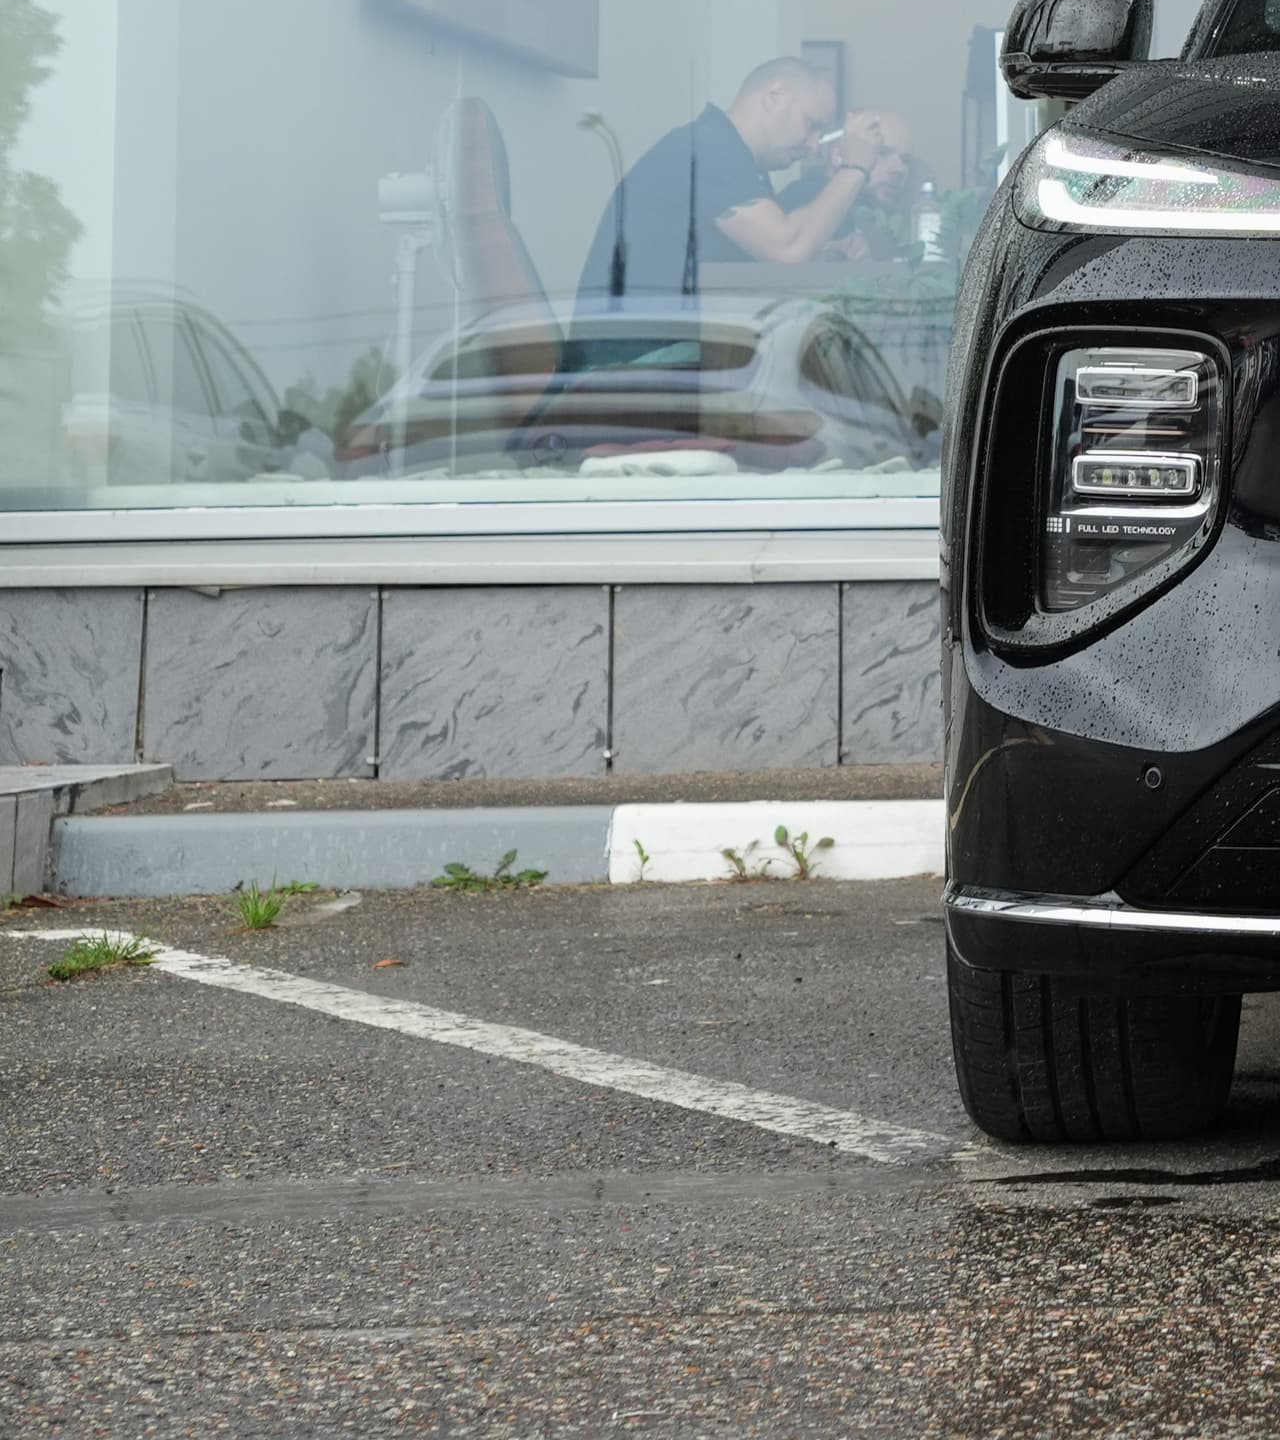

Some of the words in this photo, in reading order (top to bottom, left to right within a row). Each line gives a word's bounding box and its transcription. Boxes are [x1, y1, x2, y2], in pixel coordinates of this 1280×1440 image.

[1078, 525, 1099, 533] FULL
[1102, 525, 1119, 534] LED
[1123, 526, 1177, 536] TECHNOLOGY
